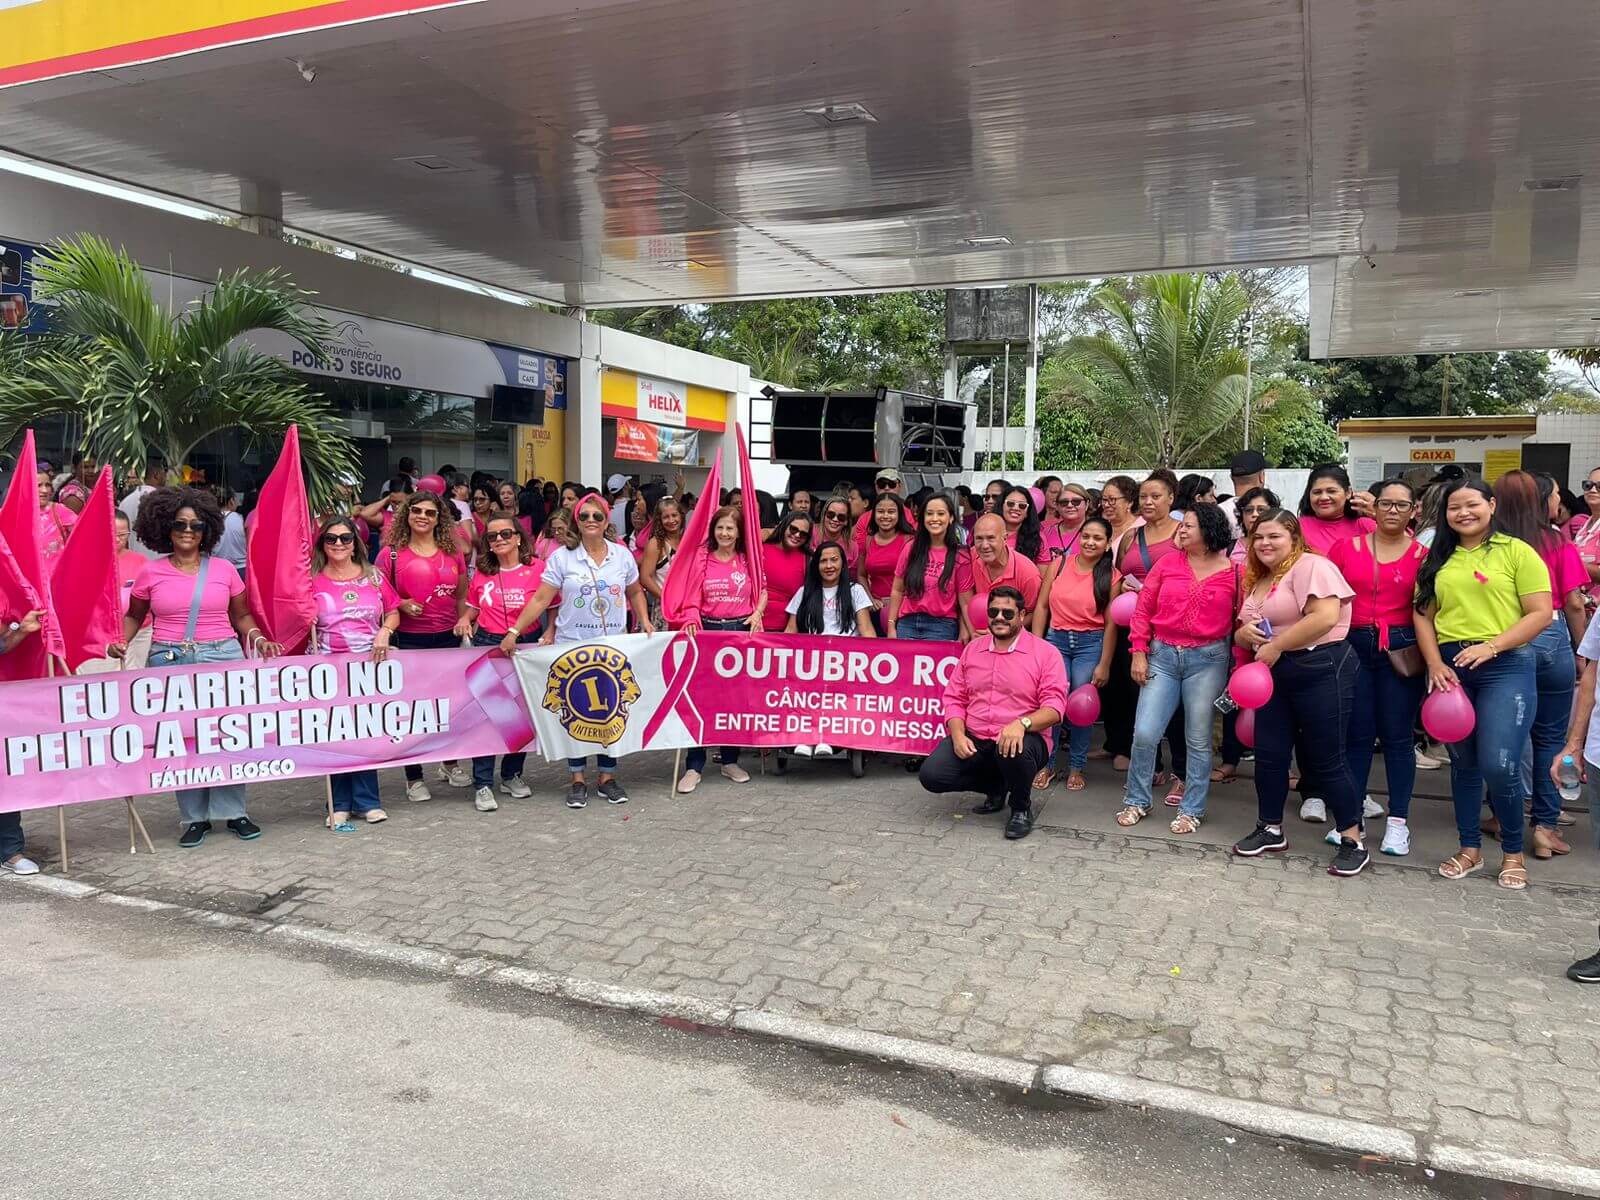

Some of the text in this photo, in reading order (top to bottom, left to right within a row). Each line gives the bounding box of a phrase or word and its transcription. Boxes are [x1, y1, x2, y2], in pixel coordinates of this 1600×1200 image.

[351, 360, 402, 380] SEGURO
[649, 393, 682, 412] HELIX
[1413, 451, 1452, 460] CAIXA
[557, 649, 620, 675] LIONS
[714, 646, 899, 684] OUTUBRO
[59, 659, 403, 724] EU CARREGO NO
[581, 676, 609, 711] L
[765, 686, 847, 711] CÂNCER
[853, 694, 894, 713] TEM
[5, 699, 450, 776] PEITO A ESPERANÇA!
[715, 713, 947, 740] ENTRE DE PEITO NESSA
[150, 758, 296, 789] FÁTIMA BOSCO
